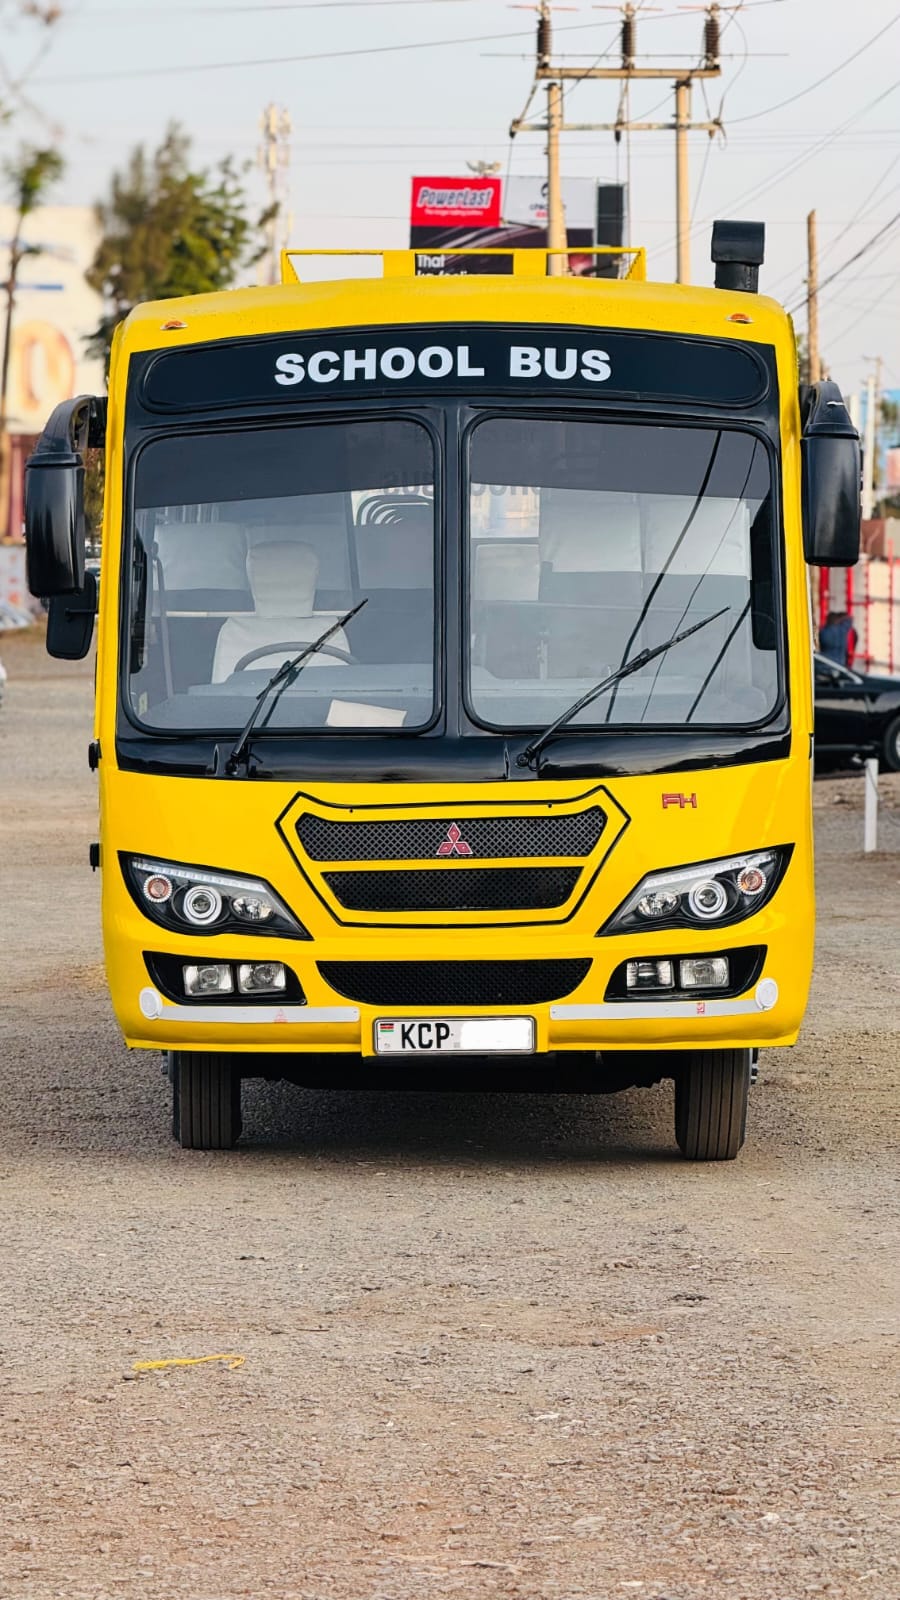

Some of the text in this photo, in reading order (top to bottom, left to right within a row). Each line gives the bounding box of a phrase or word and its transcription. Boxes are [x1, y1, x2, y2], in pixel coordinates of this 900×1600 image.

[417, 254, 445, 268] That
[274, 346, 612, 386] SCHOOL BUS
[662, 793, 697, 809] FH
[401, 1022, 450, 1049] KCP
